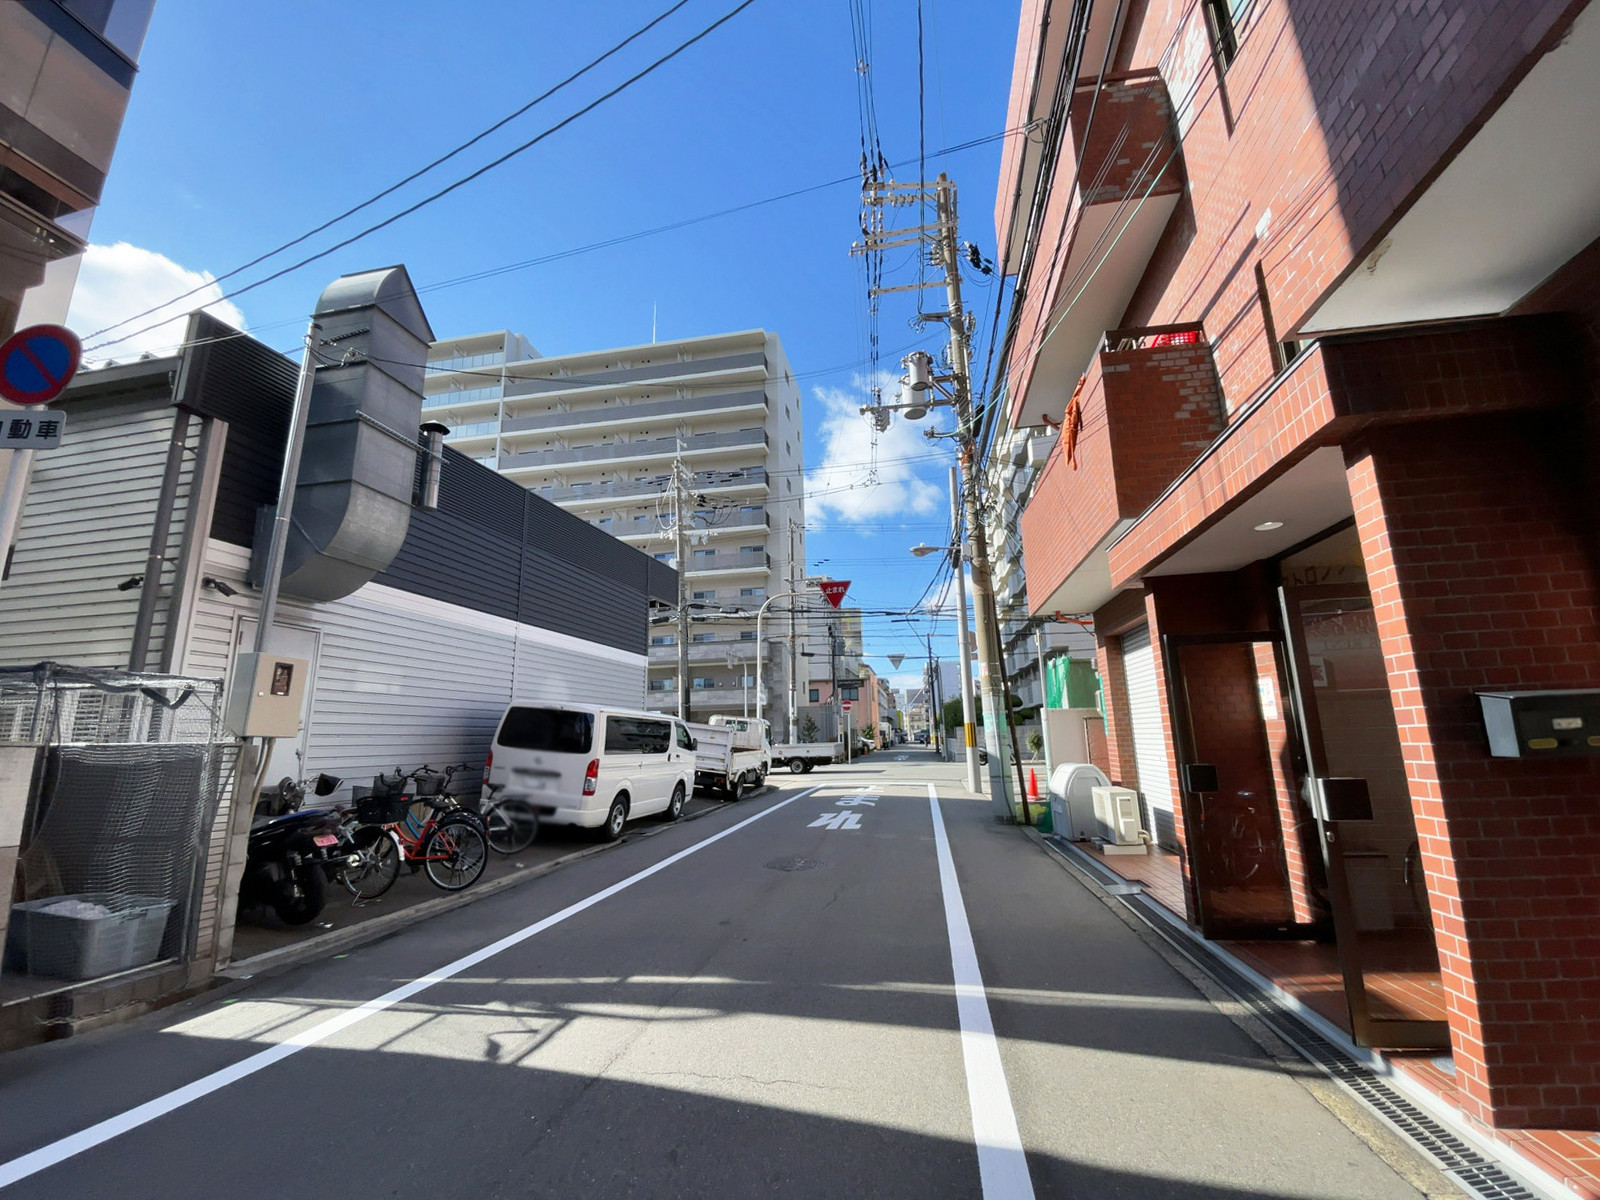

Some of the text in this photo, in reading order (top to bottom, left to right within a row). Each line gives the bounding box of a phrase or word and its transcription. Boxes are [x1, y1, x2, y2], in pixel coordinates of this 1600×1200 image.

[0, 419, 60, 440] 動車
[825, 586, 845, 595] 止まれ
[806, 785, 884, 830] 止まれ
